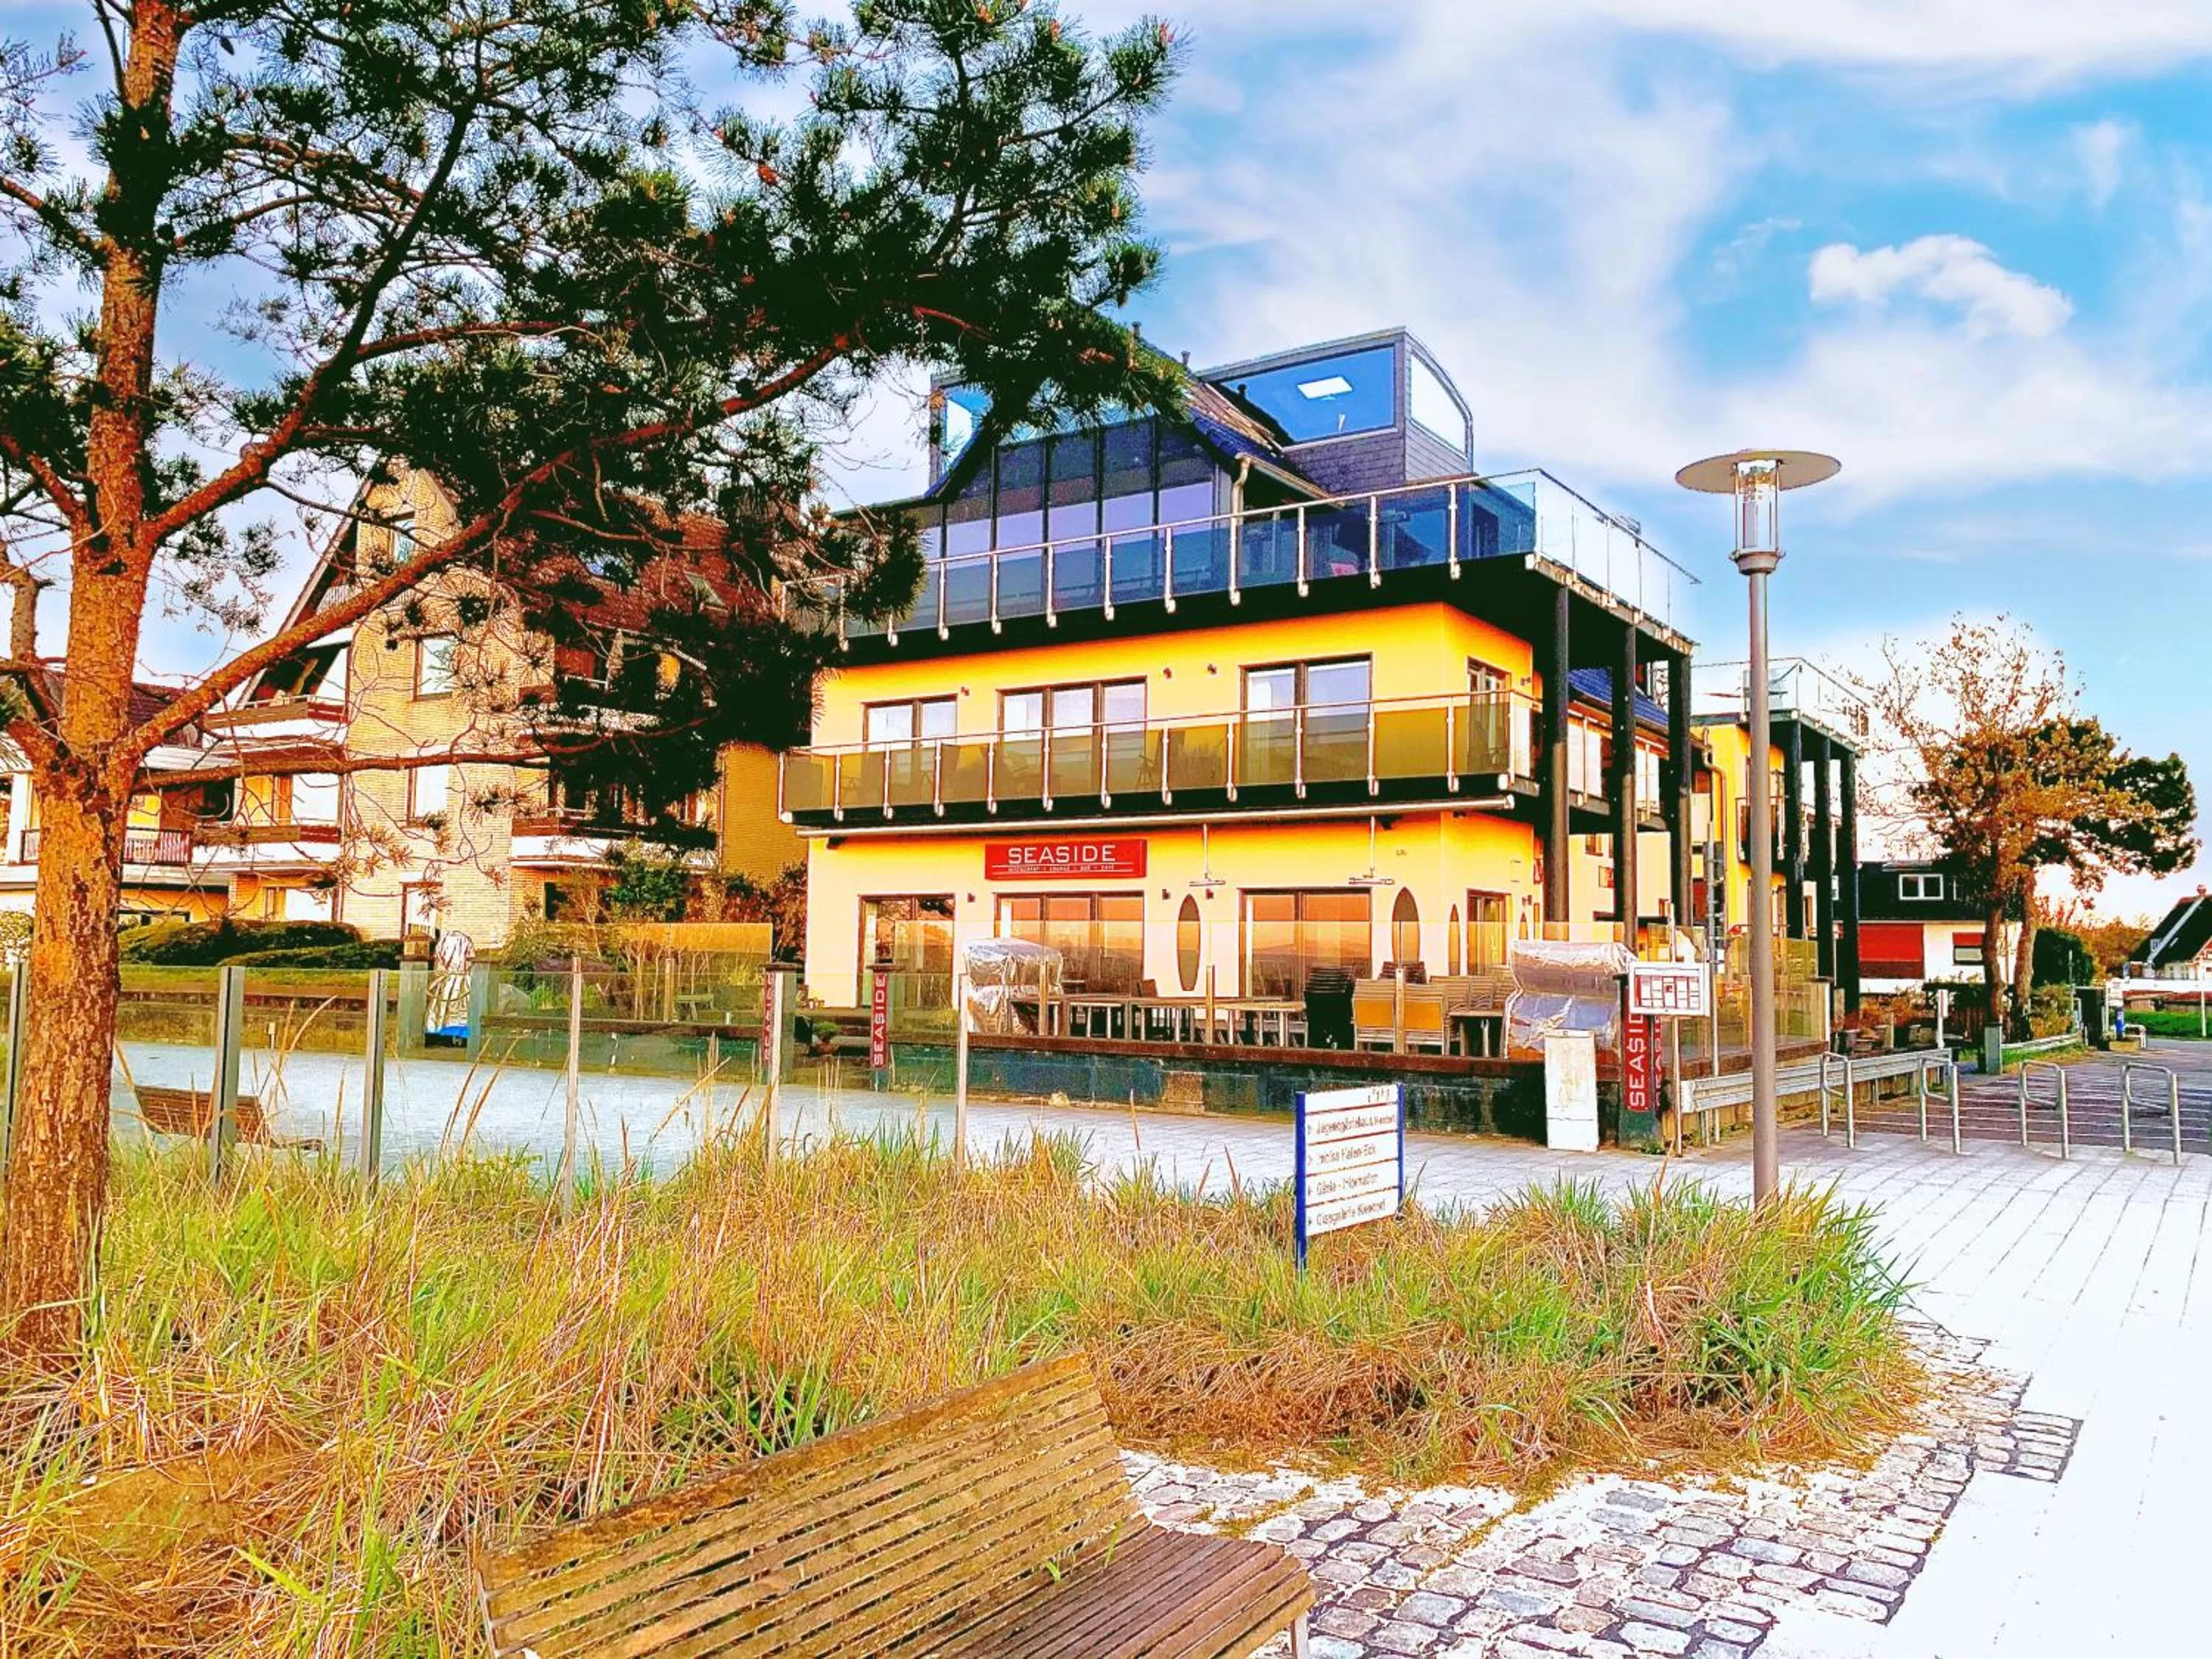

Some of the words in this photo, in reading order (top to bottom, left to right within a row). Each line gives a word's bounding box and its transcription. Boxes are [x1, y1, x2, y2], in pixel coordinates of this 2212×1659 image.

[1008, 845, 1116, 864] SEASIDE
[874, 973, 886, 1065] SEASIDE
[1627, 1015, 1646, 1107] SEASID
